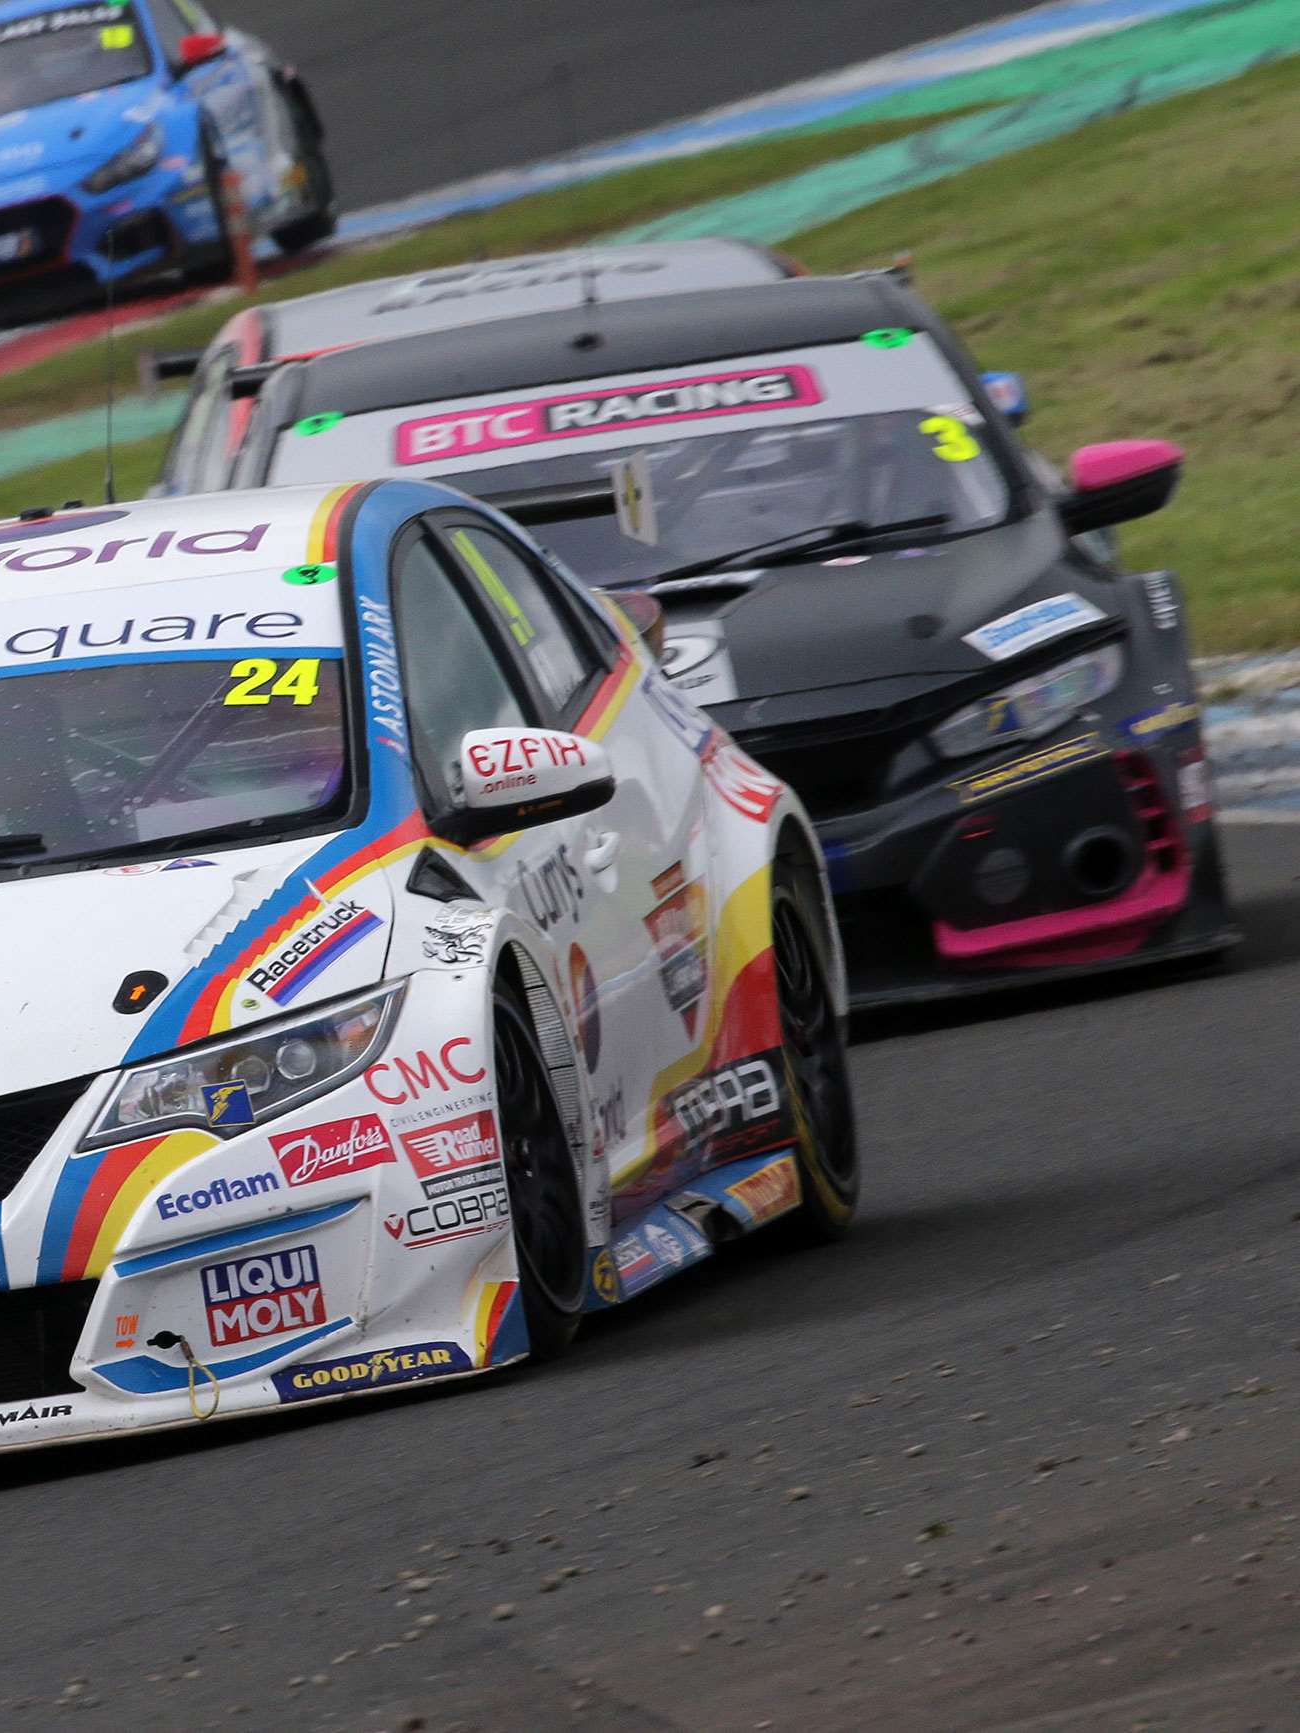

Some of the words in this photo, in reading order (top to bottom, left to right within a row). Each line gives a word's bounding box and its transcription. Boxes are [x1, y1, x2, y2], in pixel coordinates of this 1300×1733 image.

[410, 407, 536, 457] BTC
[550, 374, 793, 432] RACING
[918, 413, 982, 463] 3
[223, 658, 321, 706] 24
[247, 899, 366, 992] Racetruck
[363, 1036, 487, 1106] CMC
[278, 1119, 385, 1184] Danfoss
[156, 1169, 280, 1220] Ecoflam
[206, 1249, 315, 1301] LIQUI
[115, 1313, 139, 1336] TOW
[211, 1288, 320, 1343] MOLY
[292, 1348, 452, 1390] GOODYEAR
